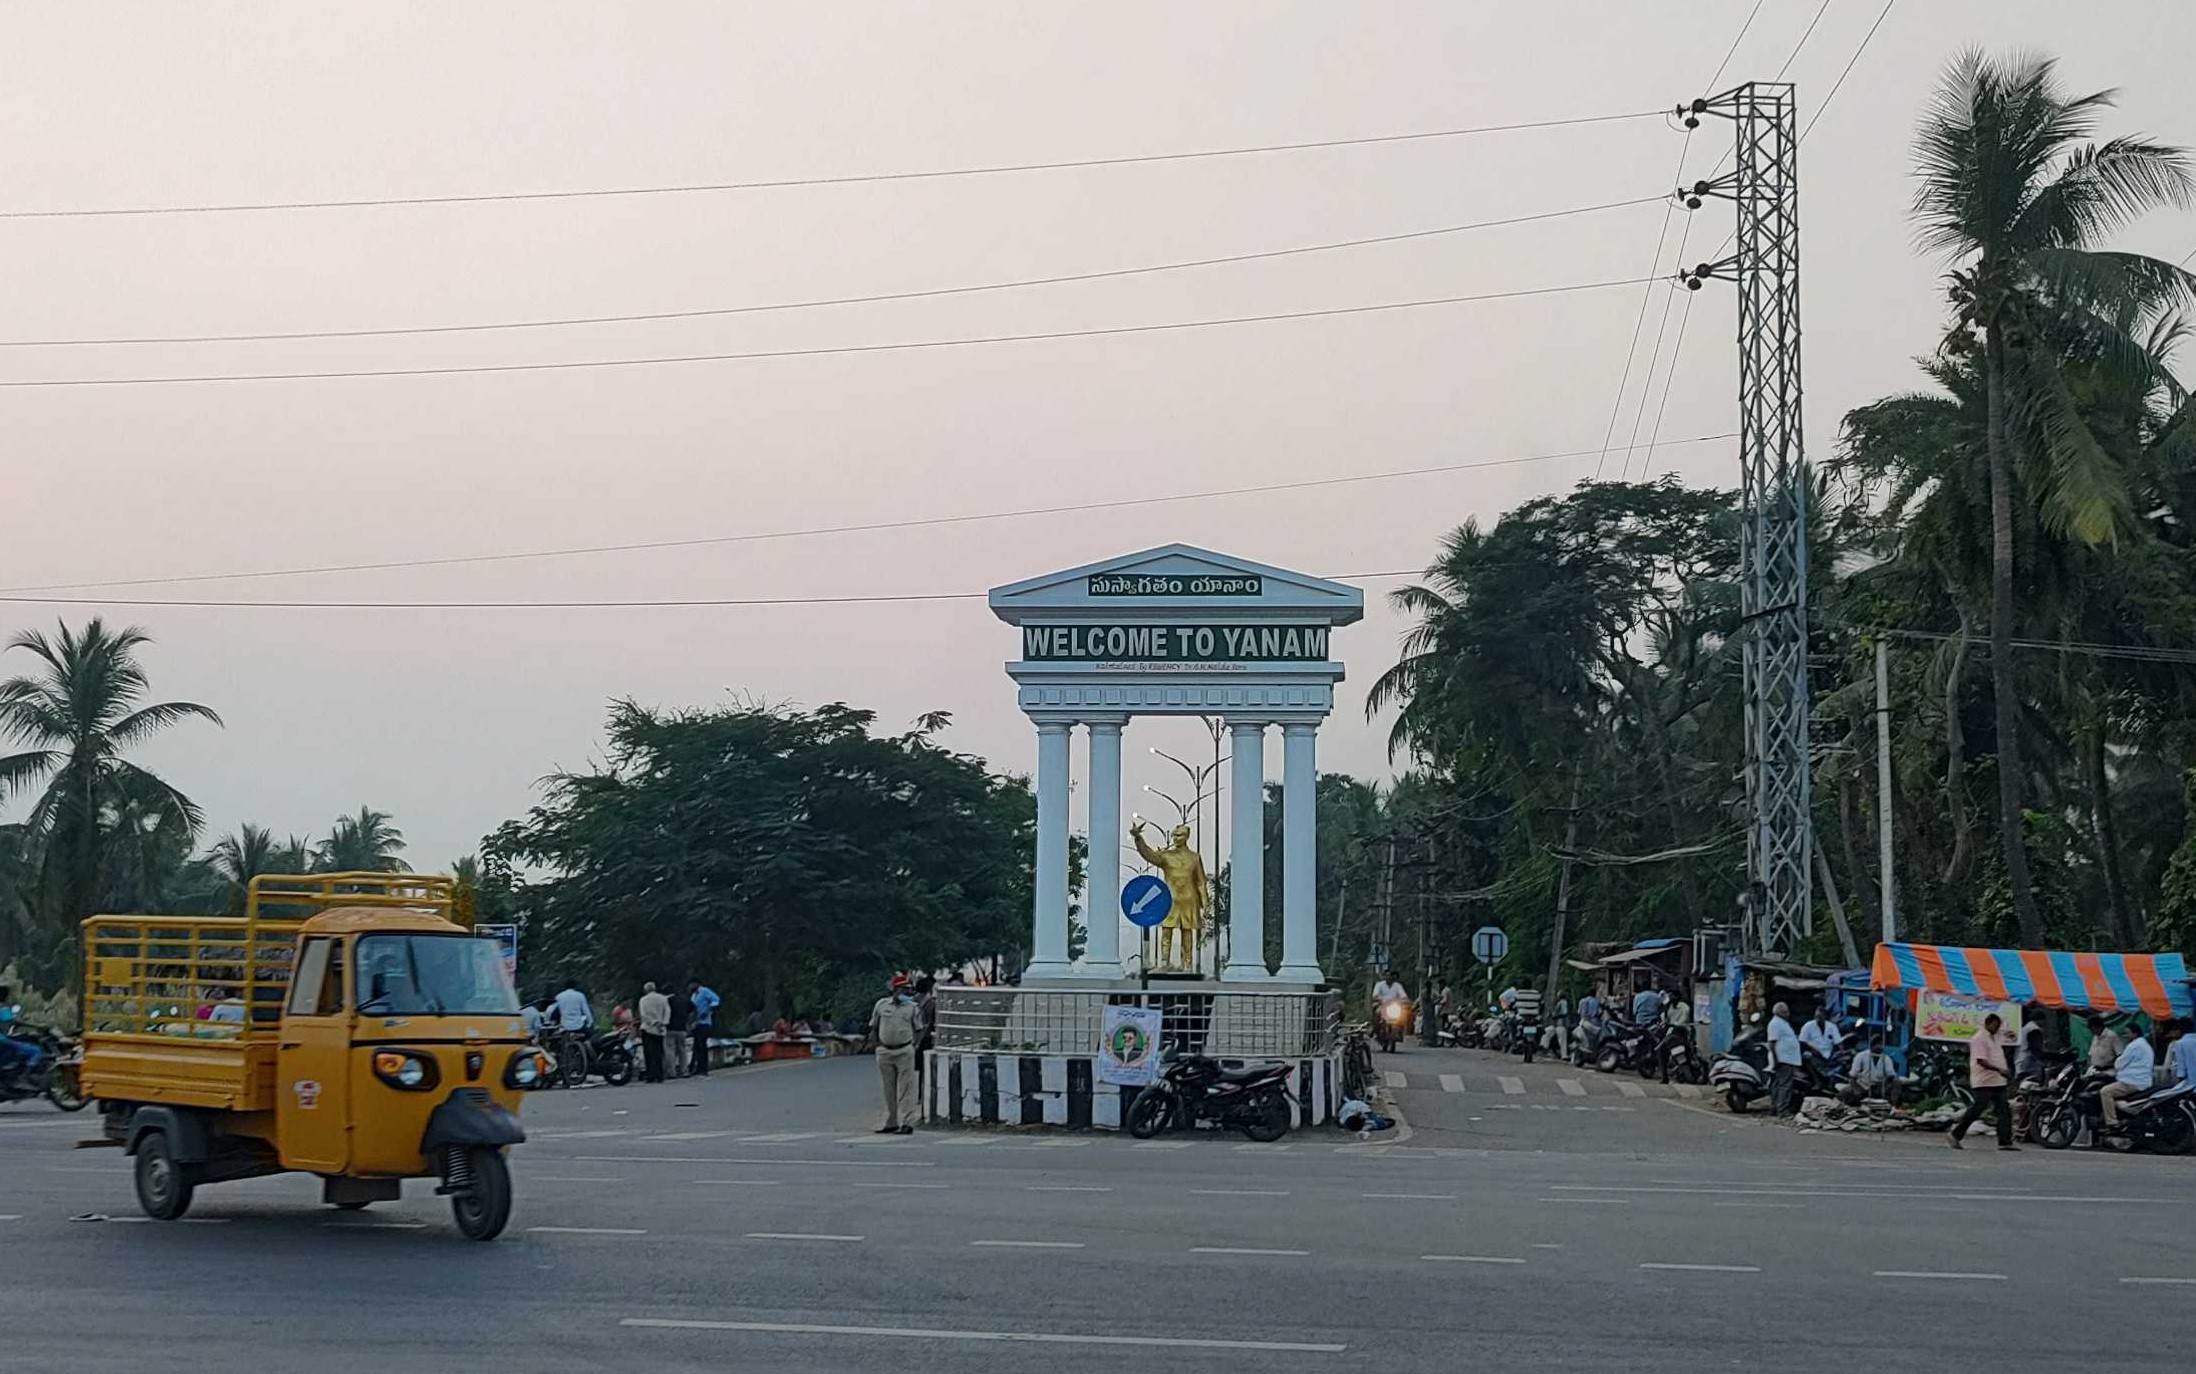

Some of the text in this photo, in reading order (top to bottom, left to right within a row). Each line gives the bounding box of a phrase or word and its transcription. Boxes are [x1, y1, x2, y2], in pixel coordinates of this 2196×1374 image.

[1190, 576, 1259, 593] యానాం
[1025, 626, 1326, 657] WELCOME TO YANAM
